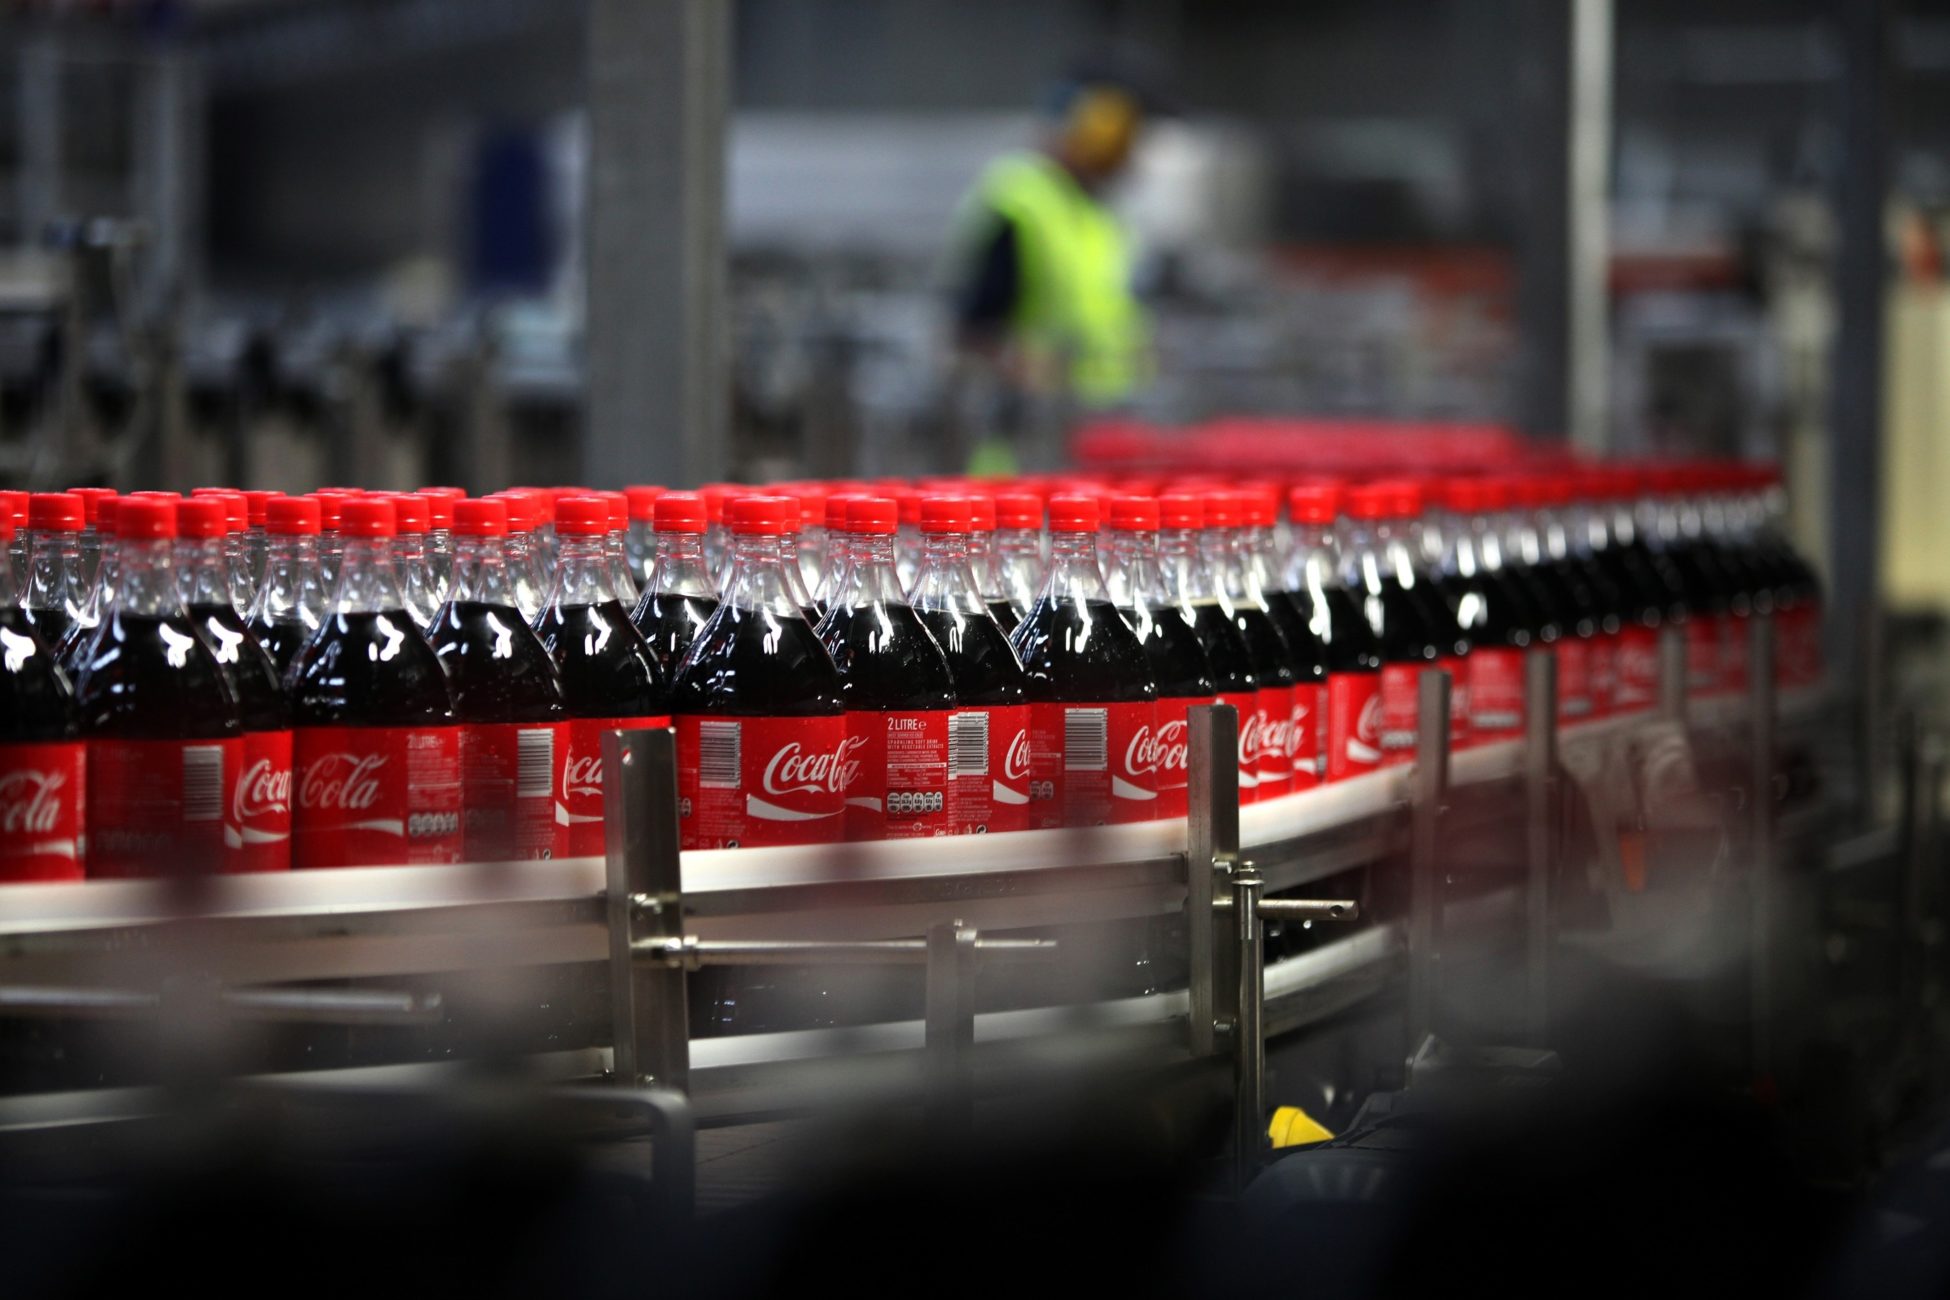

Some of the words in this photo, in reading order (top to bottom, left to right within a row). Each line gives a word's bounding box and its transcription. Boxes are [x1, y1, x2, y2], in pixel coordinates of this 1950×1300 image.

[888, 717, 894, 731] 2
[895, 718, 918, 731] LITRE
[300, 753, 389, 810] Cola
